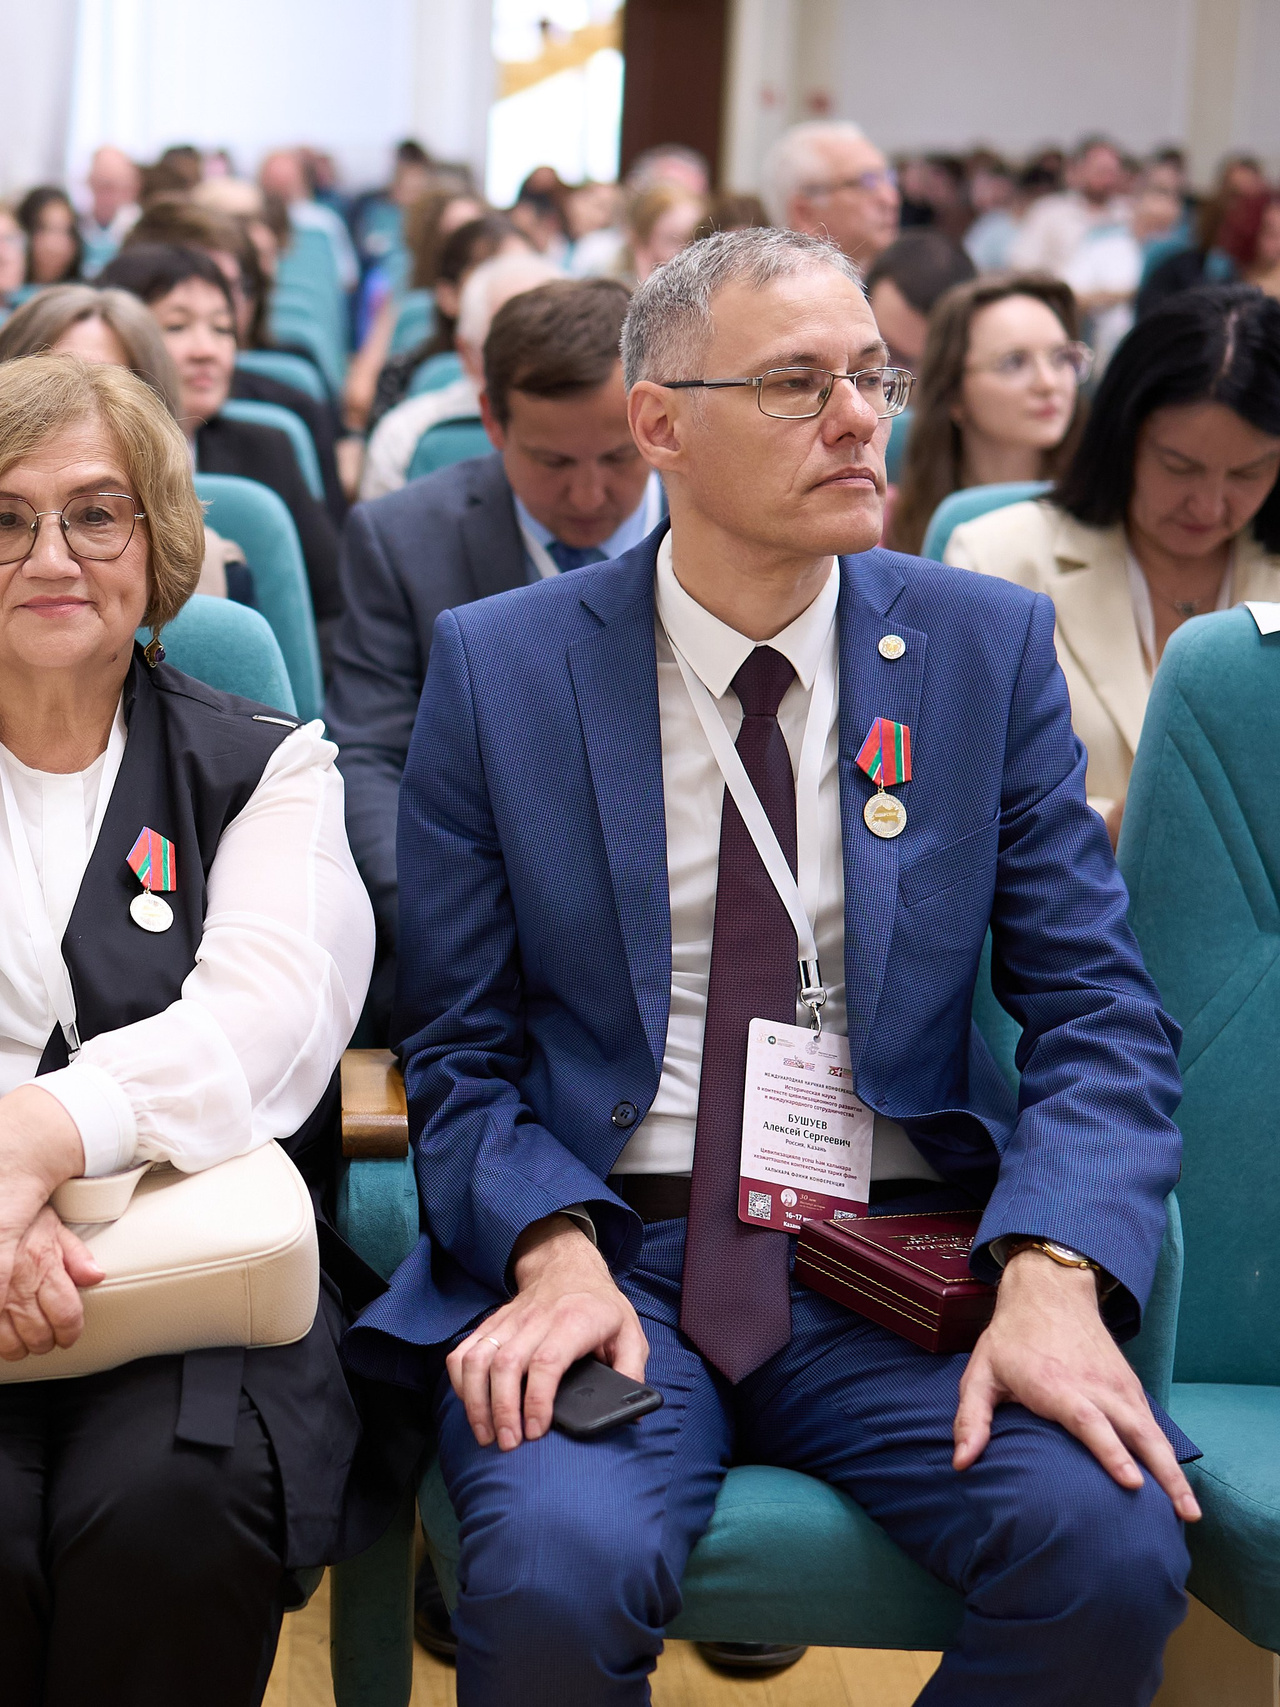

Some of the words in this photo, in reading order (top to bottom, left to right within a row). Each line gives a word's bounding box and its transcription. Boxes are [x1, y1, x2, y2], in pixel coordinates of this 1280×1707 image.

[788, 1113, 828, 1130] БУШУЕВ
[762, 1121, 801, 1137] Алексей
[803, 1129, 851, 1148] Сергеевич
[807, 1143, 827, 1153] Казань
